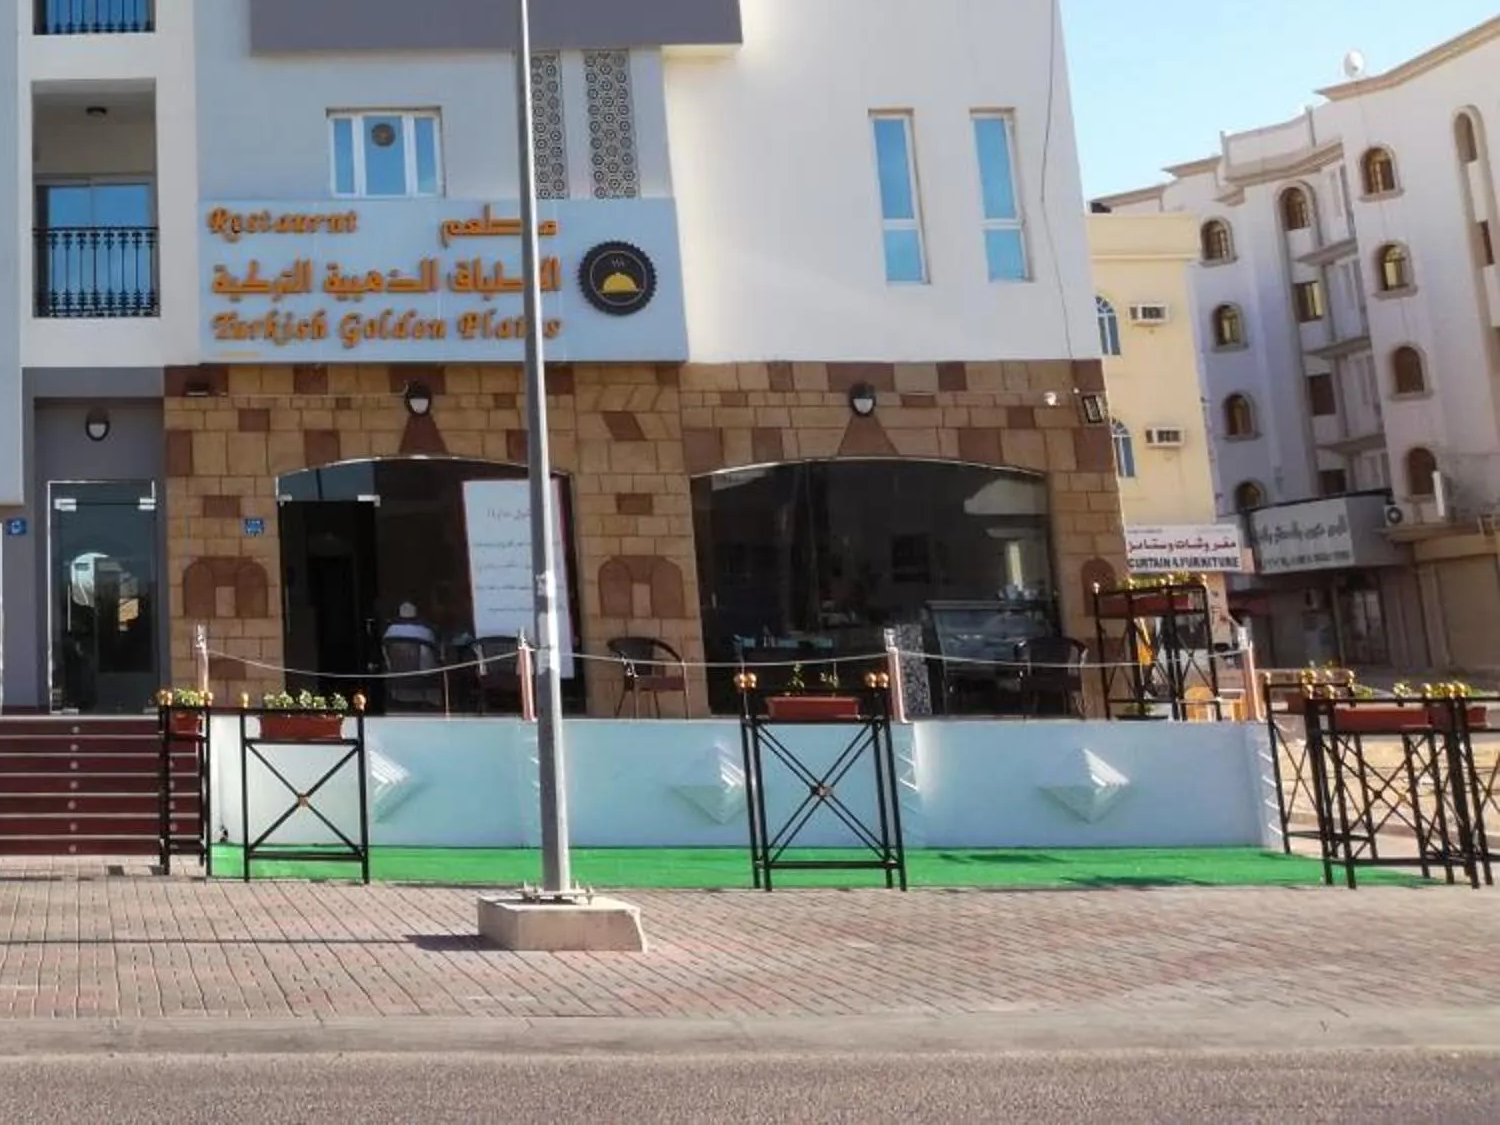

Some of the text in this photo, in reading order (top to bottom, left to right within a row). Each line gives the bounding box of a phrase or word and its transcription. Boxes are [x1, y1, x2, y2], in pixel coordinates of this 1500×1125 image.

[212, 308, 562, 349] Turkish Golden Plats
[1126, 558, 1171, 568] CURTAIN
